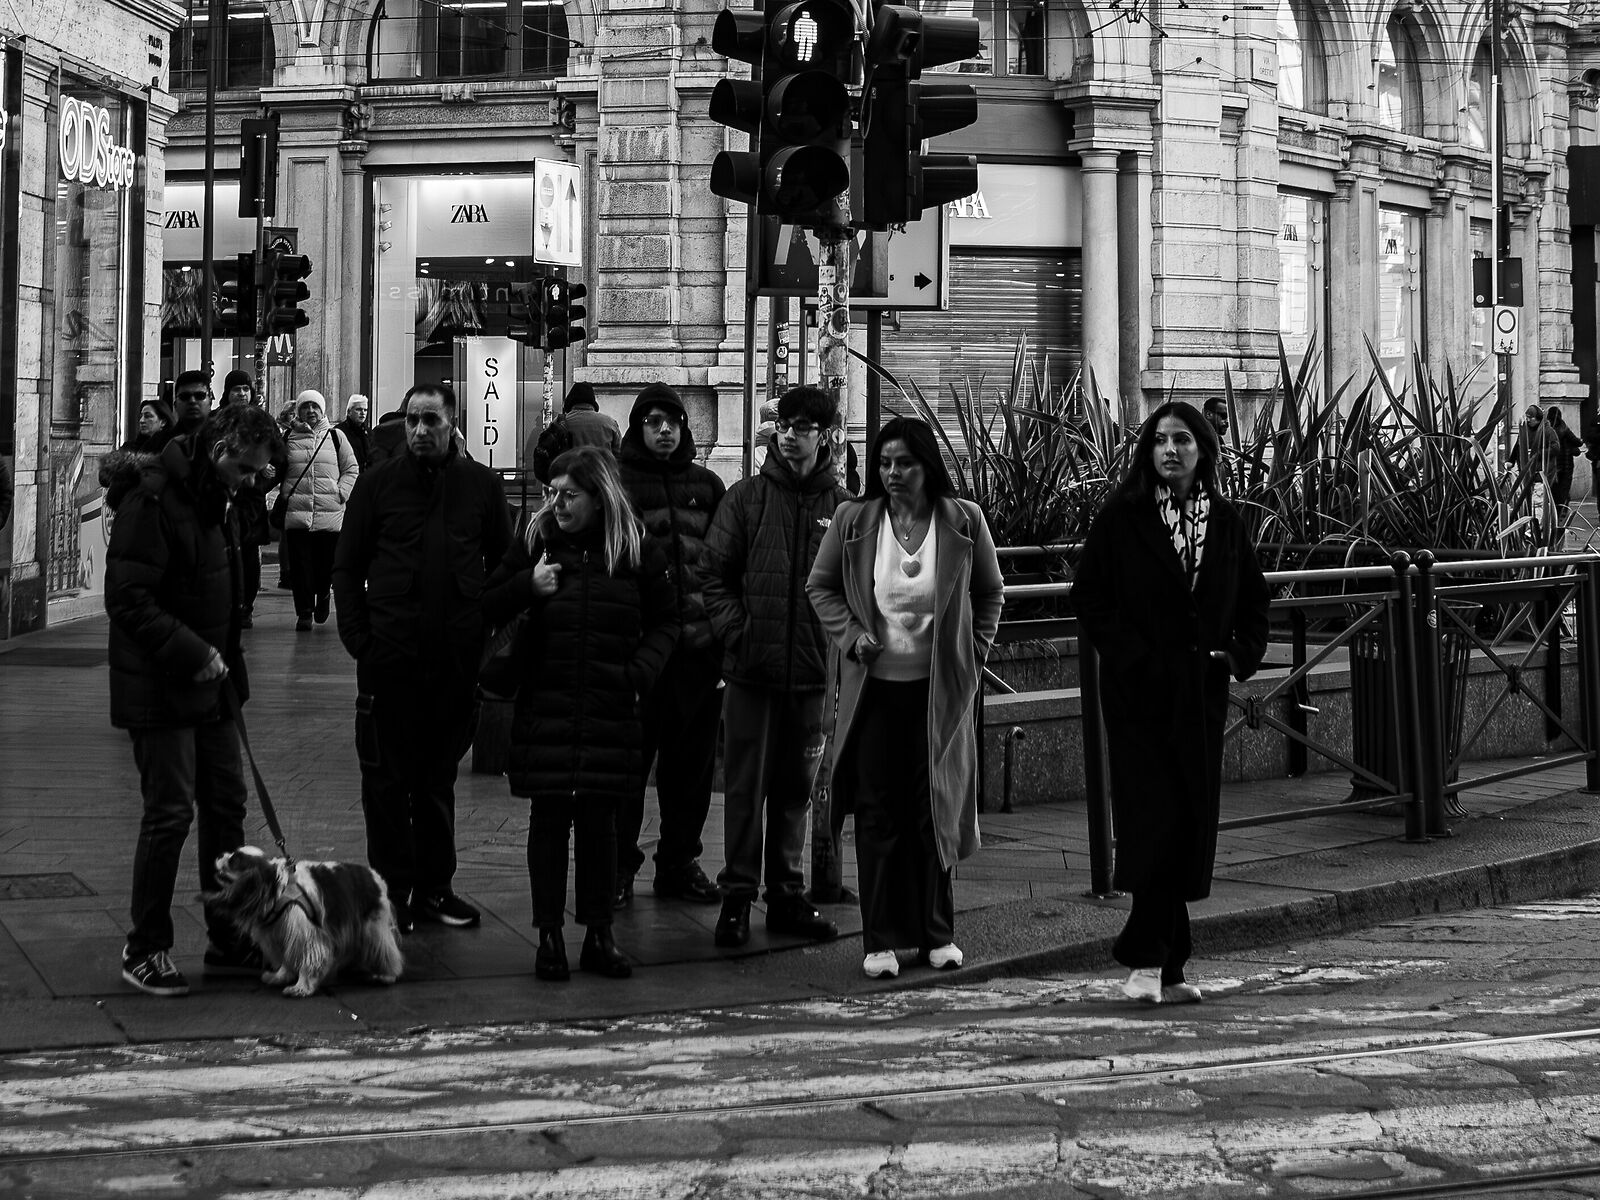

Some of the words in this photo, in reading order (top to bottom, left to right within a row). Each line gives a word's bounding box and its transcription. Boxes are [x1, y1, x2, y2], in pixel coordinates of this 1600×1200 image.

[451, 204, 490, 223] ZARA
[949, 190, 993, 218] ARA
[165, 210, 201, 228] ZARA
[484, 357, 500, 468] SALDI
